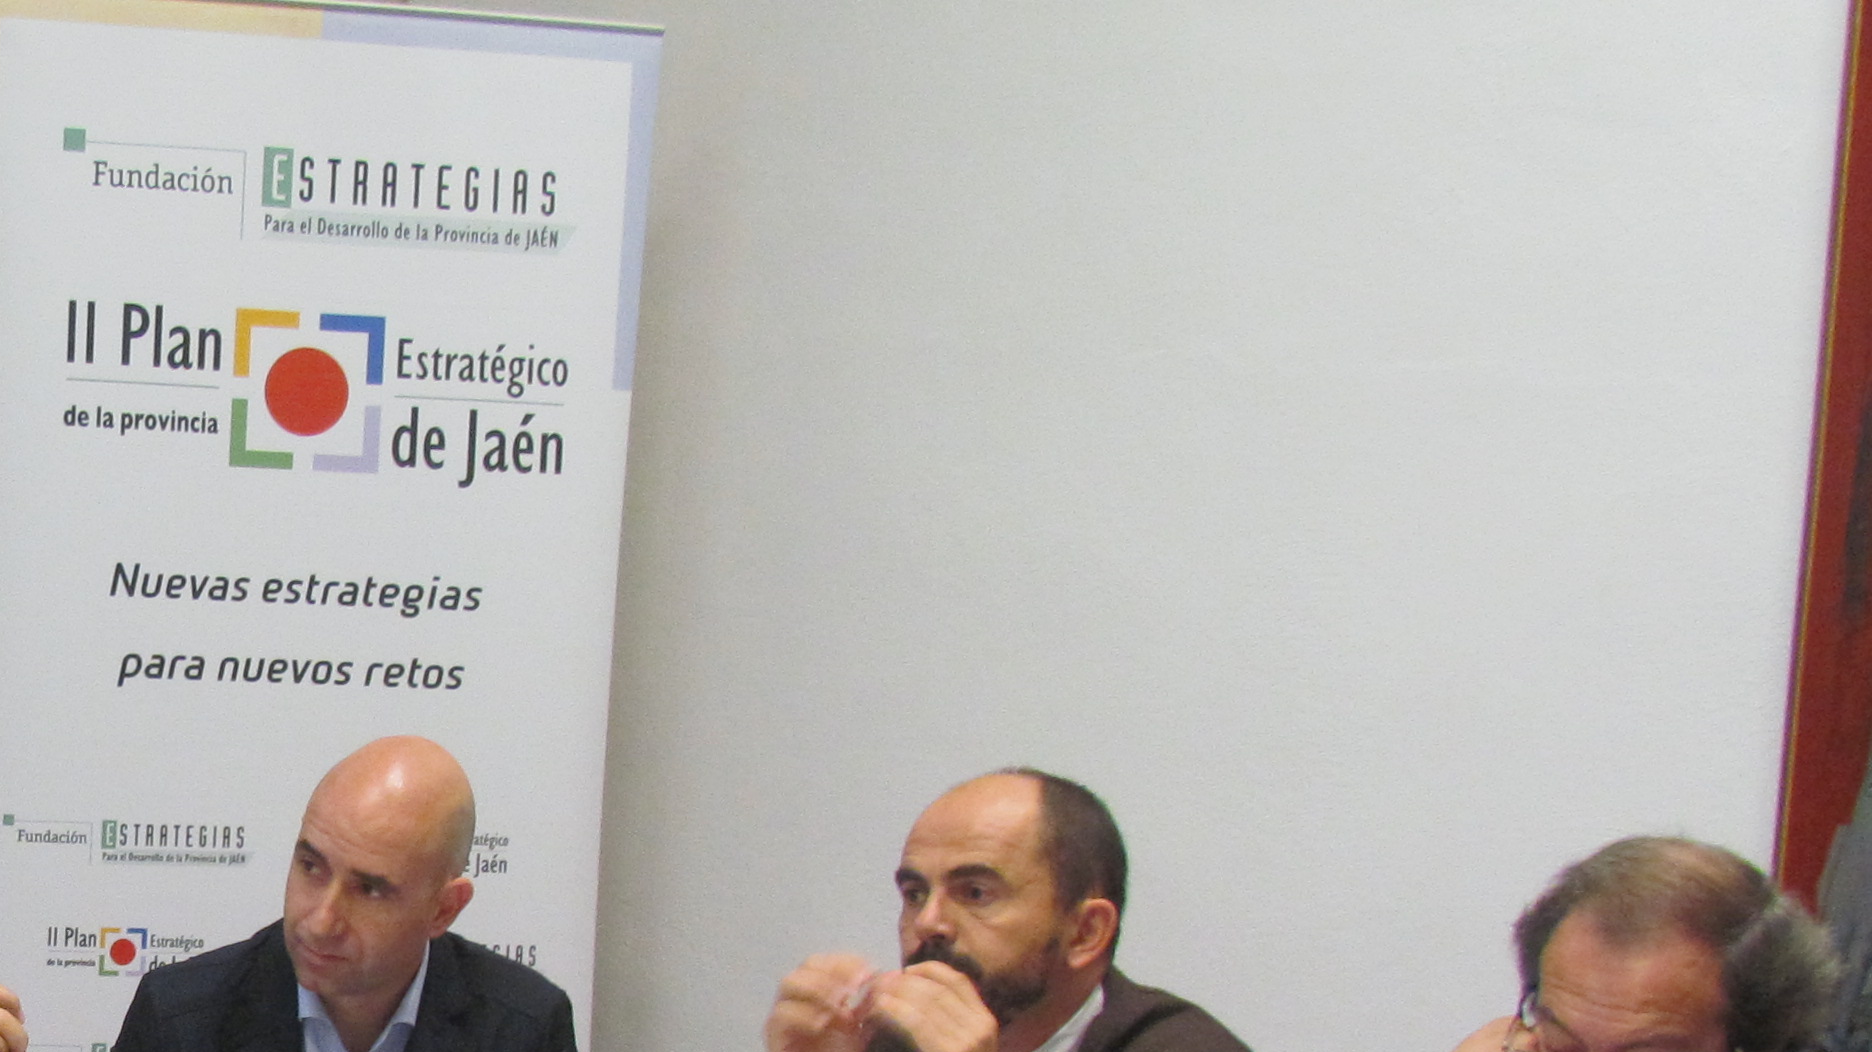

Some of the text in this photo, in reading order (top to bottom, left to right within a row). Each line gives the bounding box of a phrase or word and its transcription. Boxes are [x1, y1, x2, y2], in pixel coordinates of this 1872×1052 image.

[92, 154, 556, 216] Fundación ESTRATEGIAS
[264, 214, 559, 250] Para el Desarrollo de la Provincia de JAÉN
[66, 300, 223, 371] II Plan
[397, 339, 569, 397] Estratégico
[63, 405, 219, 435] de la provincia
[392, 407, 564, 488] de Jaén
[109, 562, 483, 618] Nuevas estrategias
[117, 653, 465, 689] para nuevos retos
[17, 822, 245, 849] Fundación ESTRATEGIAS
[474, 853, 508, 878] Jaén
[48, 927, 97, 948] II Plan
[150, 934, 204, 951] Estratégico
[47, 958, 96, 968] de la provincia
